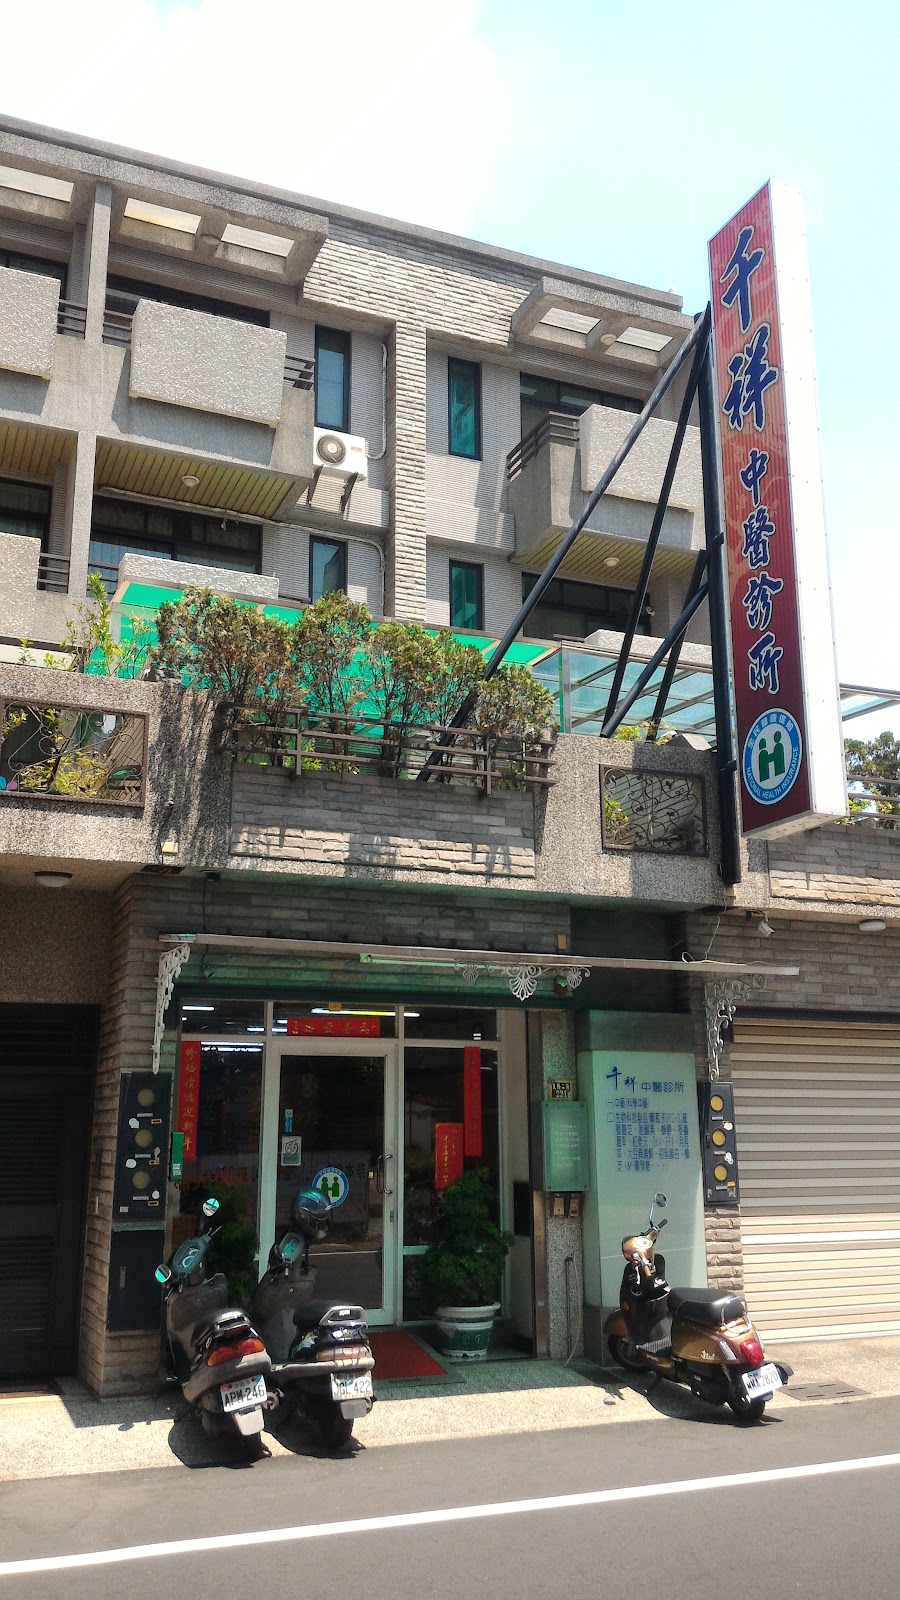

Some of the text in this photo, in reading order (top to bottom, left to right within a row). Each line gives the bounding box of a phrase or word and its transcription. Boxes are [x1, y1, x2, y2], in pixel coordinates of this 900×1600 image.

[745, 745, 799, 800] NATIONAL HEALTH INSURANCE
[555, 1089, 568, 1098] 221
